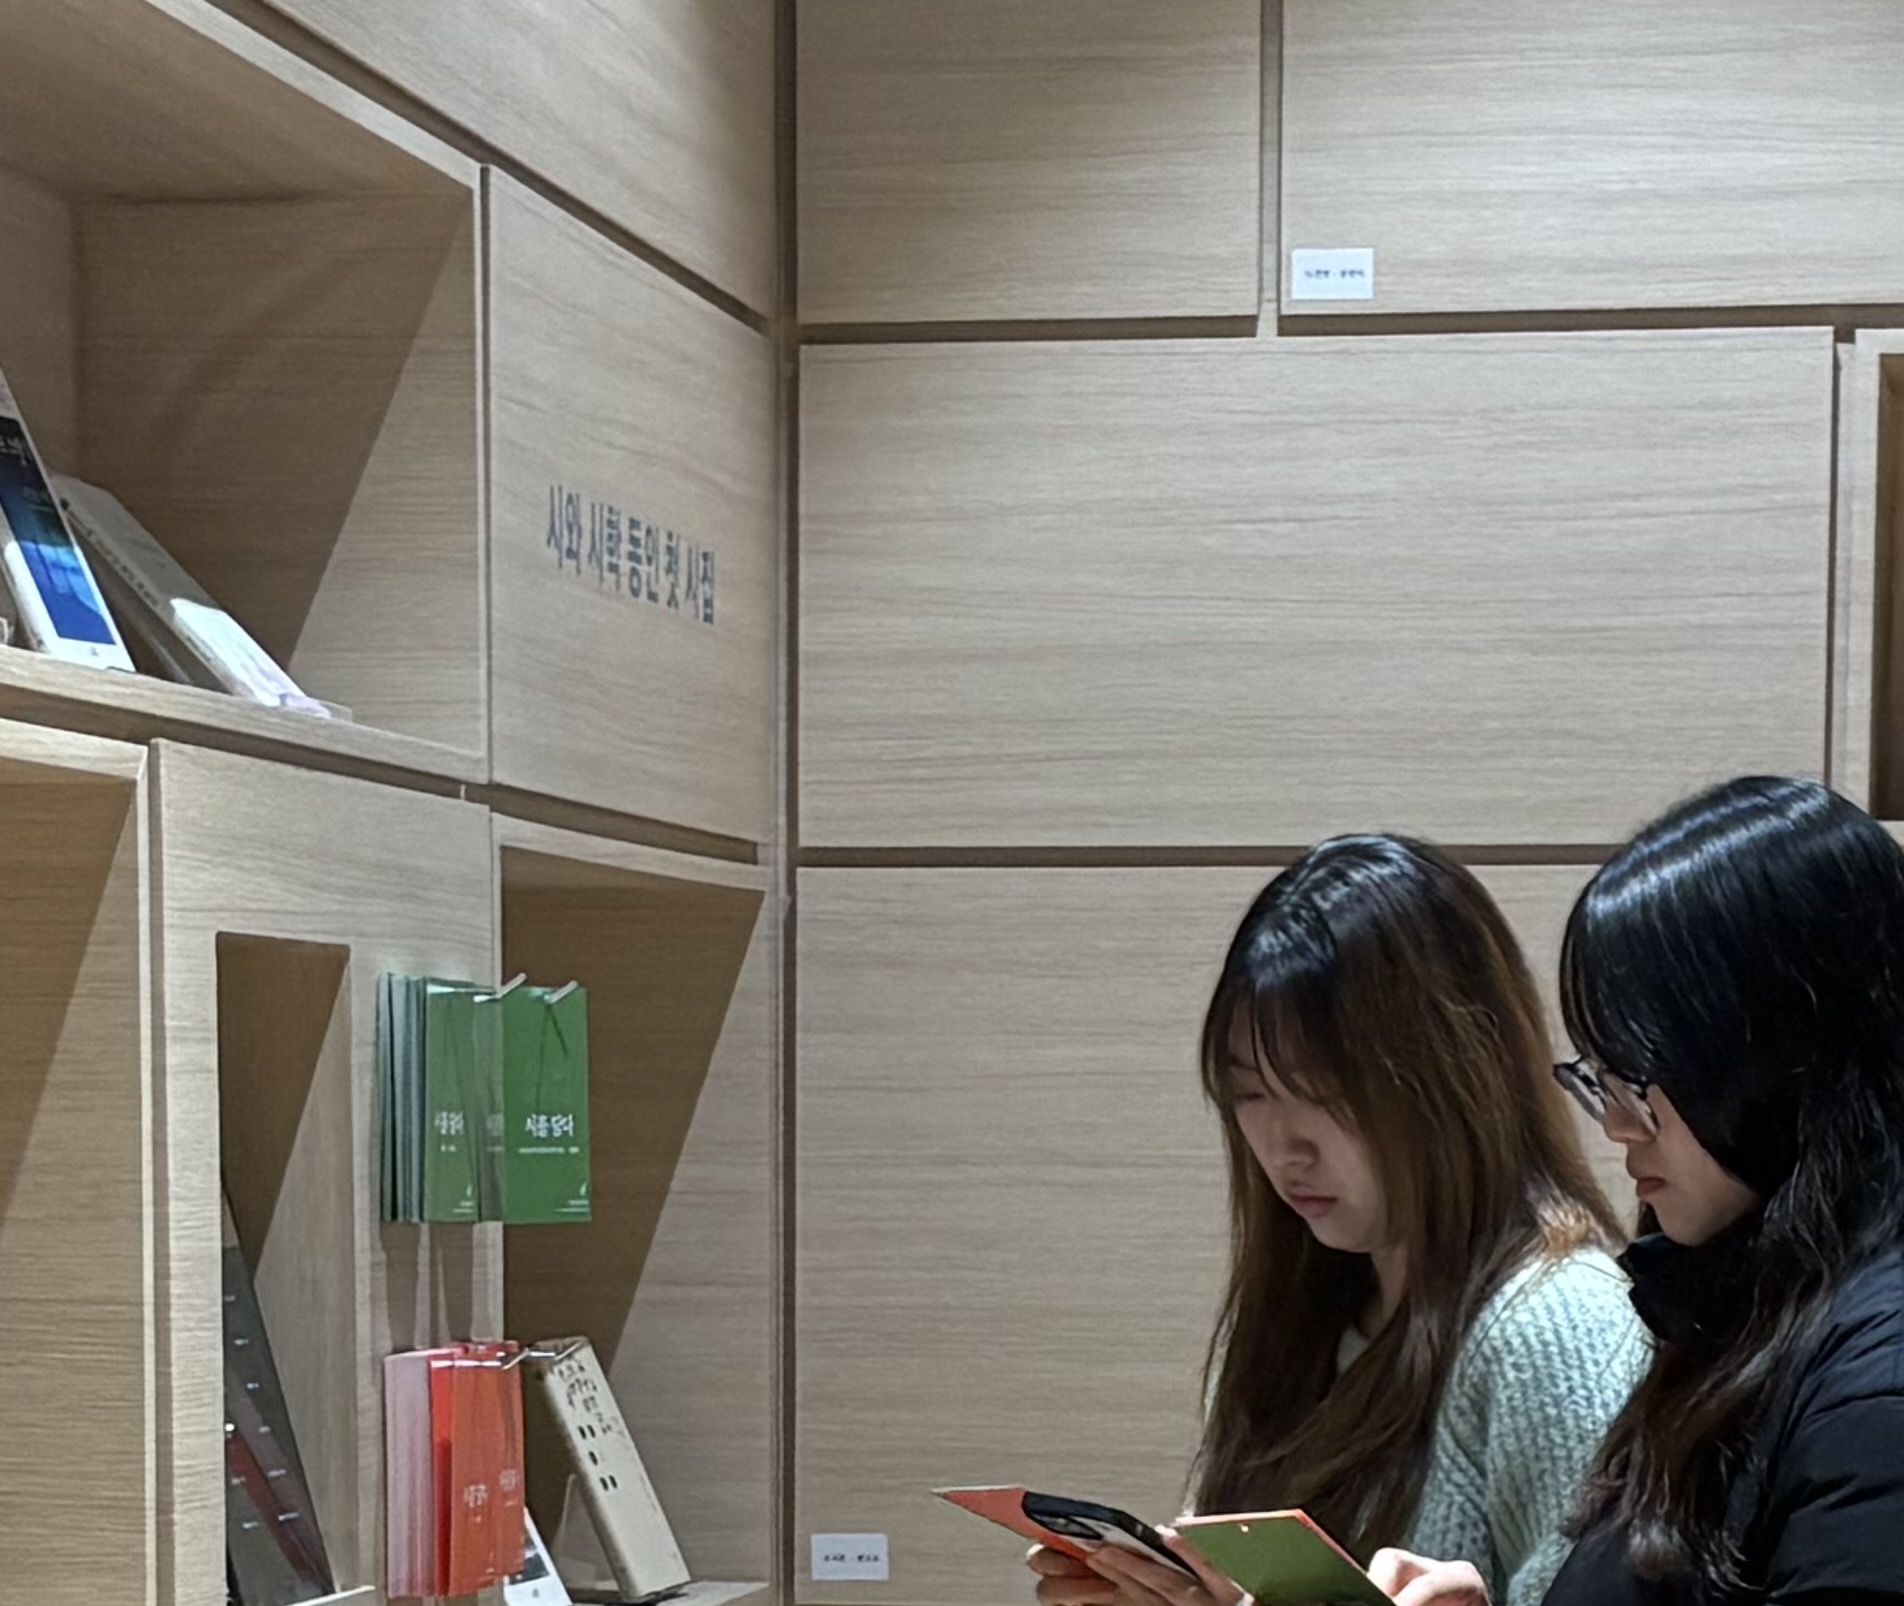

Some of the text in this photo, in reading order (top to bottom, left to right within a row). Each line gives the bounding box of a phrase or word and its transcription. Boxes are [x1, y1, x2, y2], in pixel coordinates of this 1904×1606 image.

[547, 484, 582, 577] 시와
[666, 530, 680, 610] 첫
[684, 543, 714, 626] 시집
